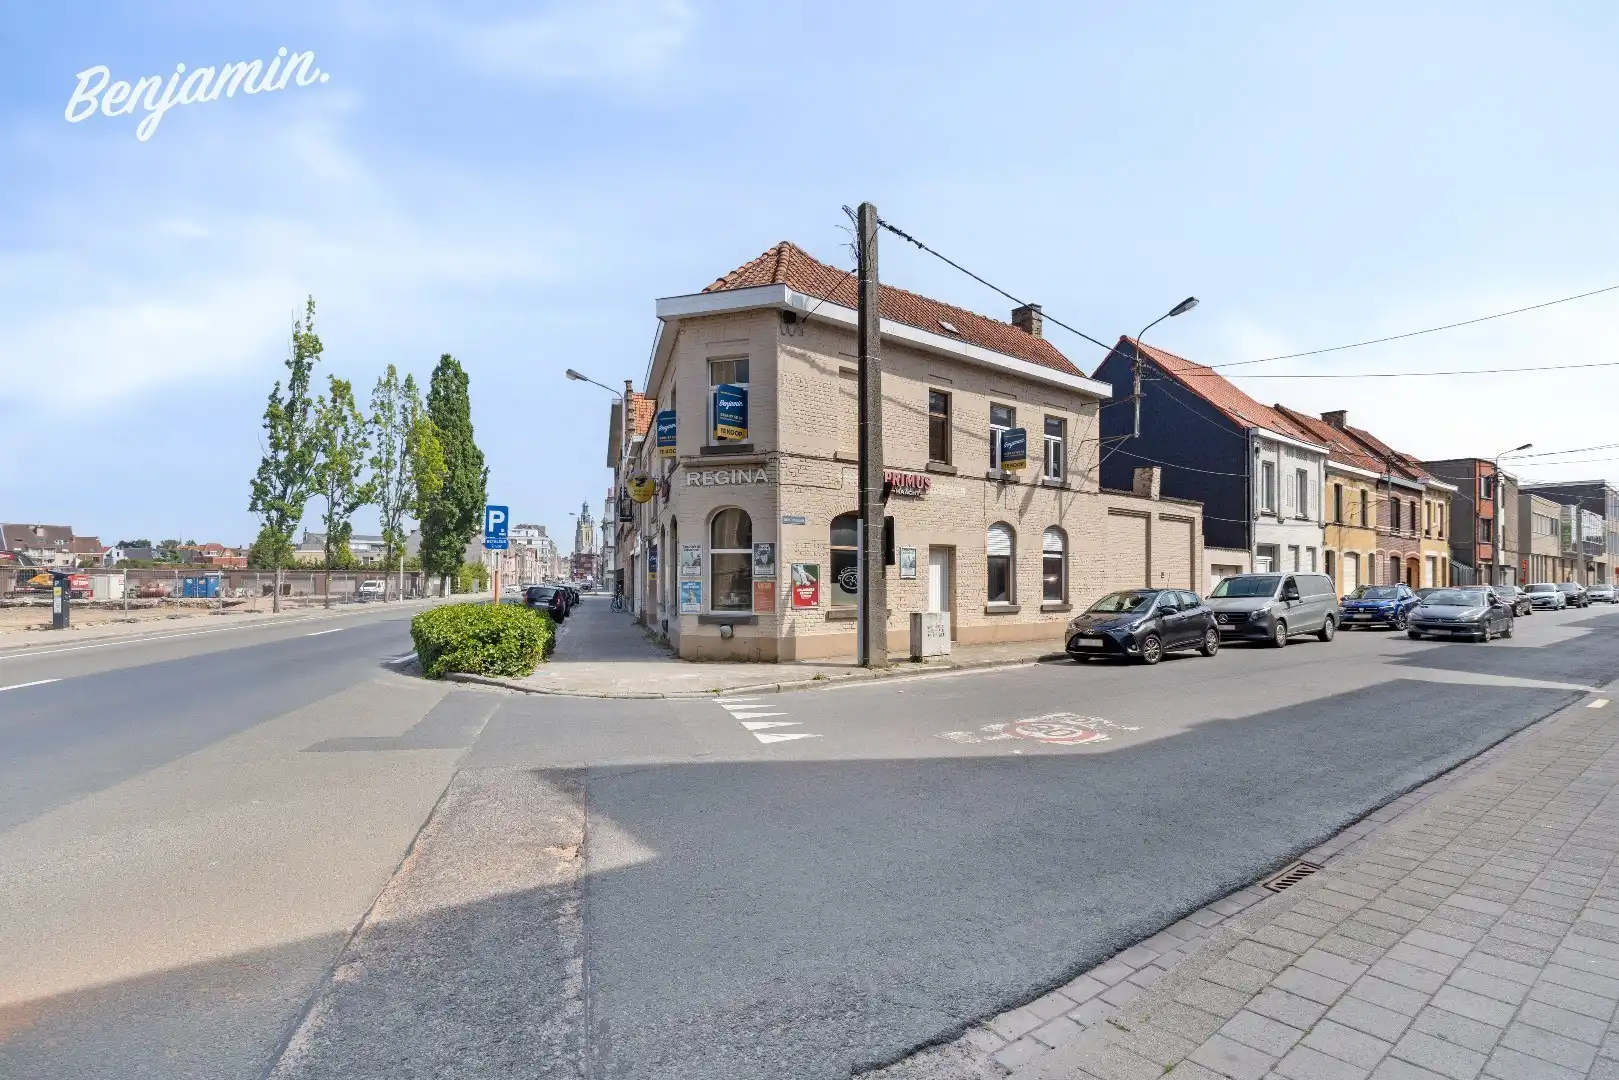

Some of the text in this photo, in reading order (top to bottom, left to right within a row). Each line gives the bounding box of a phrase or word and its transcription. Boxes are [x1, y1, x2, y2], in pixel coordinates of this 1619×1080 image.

[686, 468, 769, 486] REGINA
[884, 471, 932, 490] PRIMUS
[489, 510, 505, 532] P
